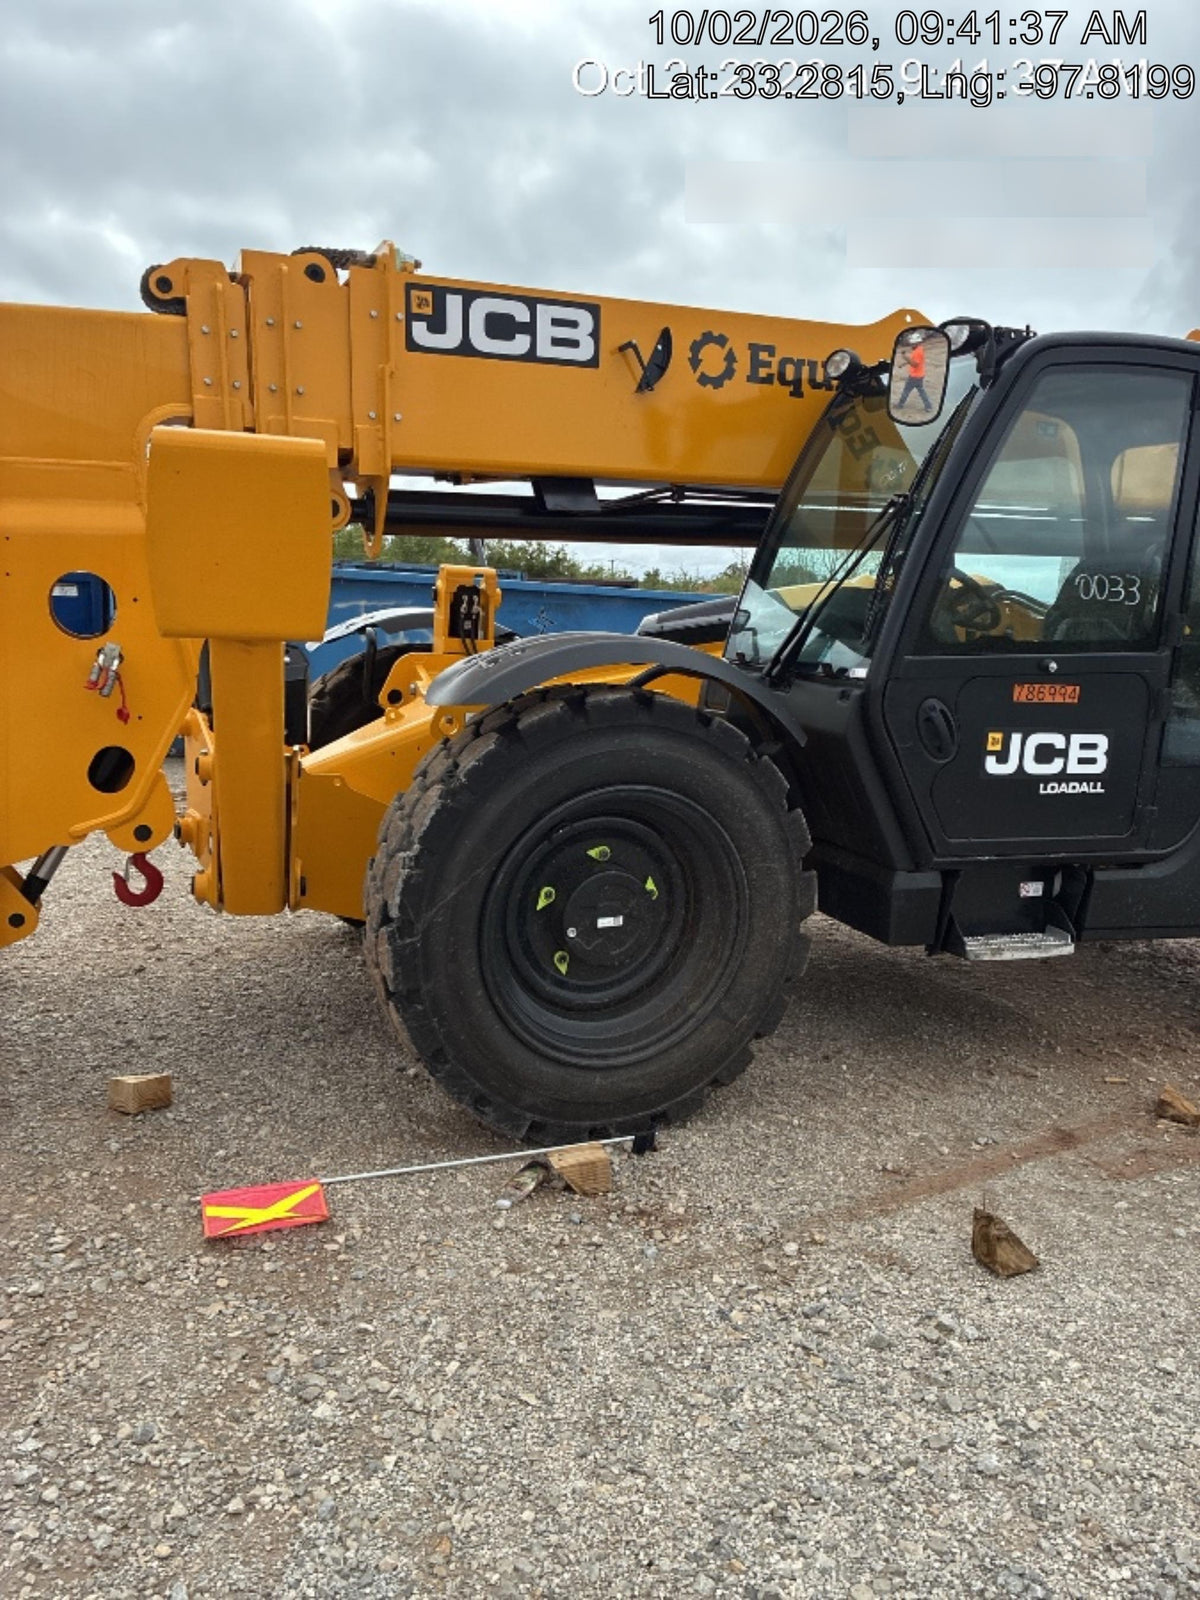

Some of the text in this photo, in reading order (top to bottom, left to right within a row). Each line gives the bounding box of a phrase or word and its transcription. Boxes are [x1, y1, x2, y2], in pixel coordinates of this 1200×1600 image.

[411, 293, 595, 362] JCB
[746, 342, 842, 399] Equ
[1015, 684, 1077, 702] 786994
[985, 731, 1109, 775] JCB
[1039, 781, 1105, 794] LOADALL
